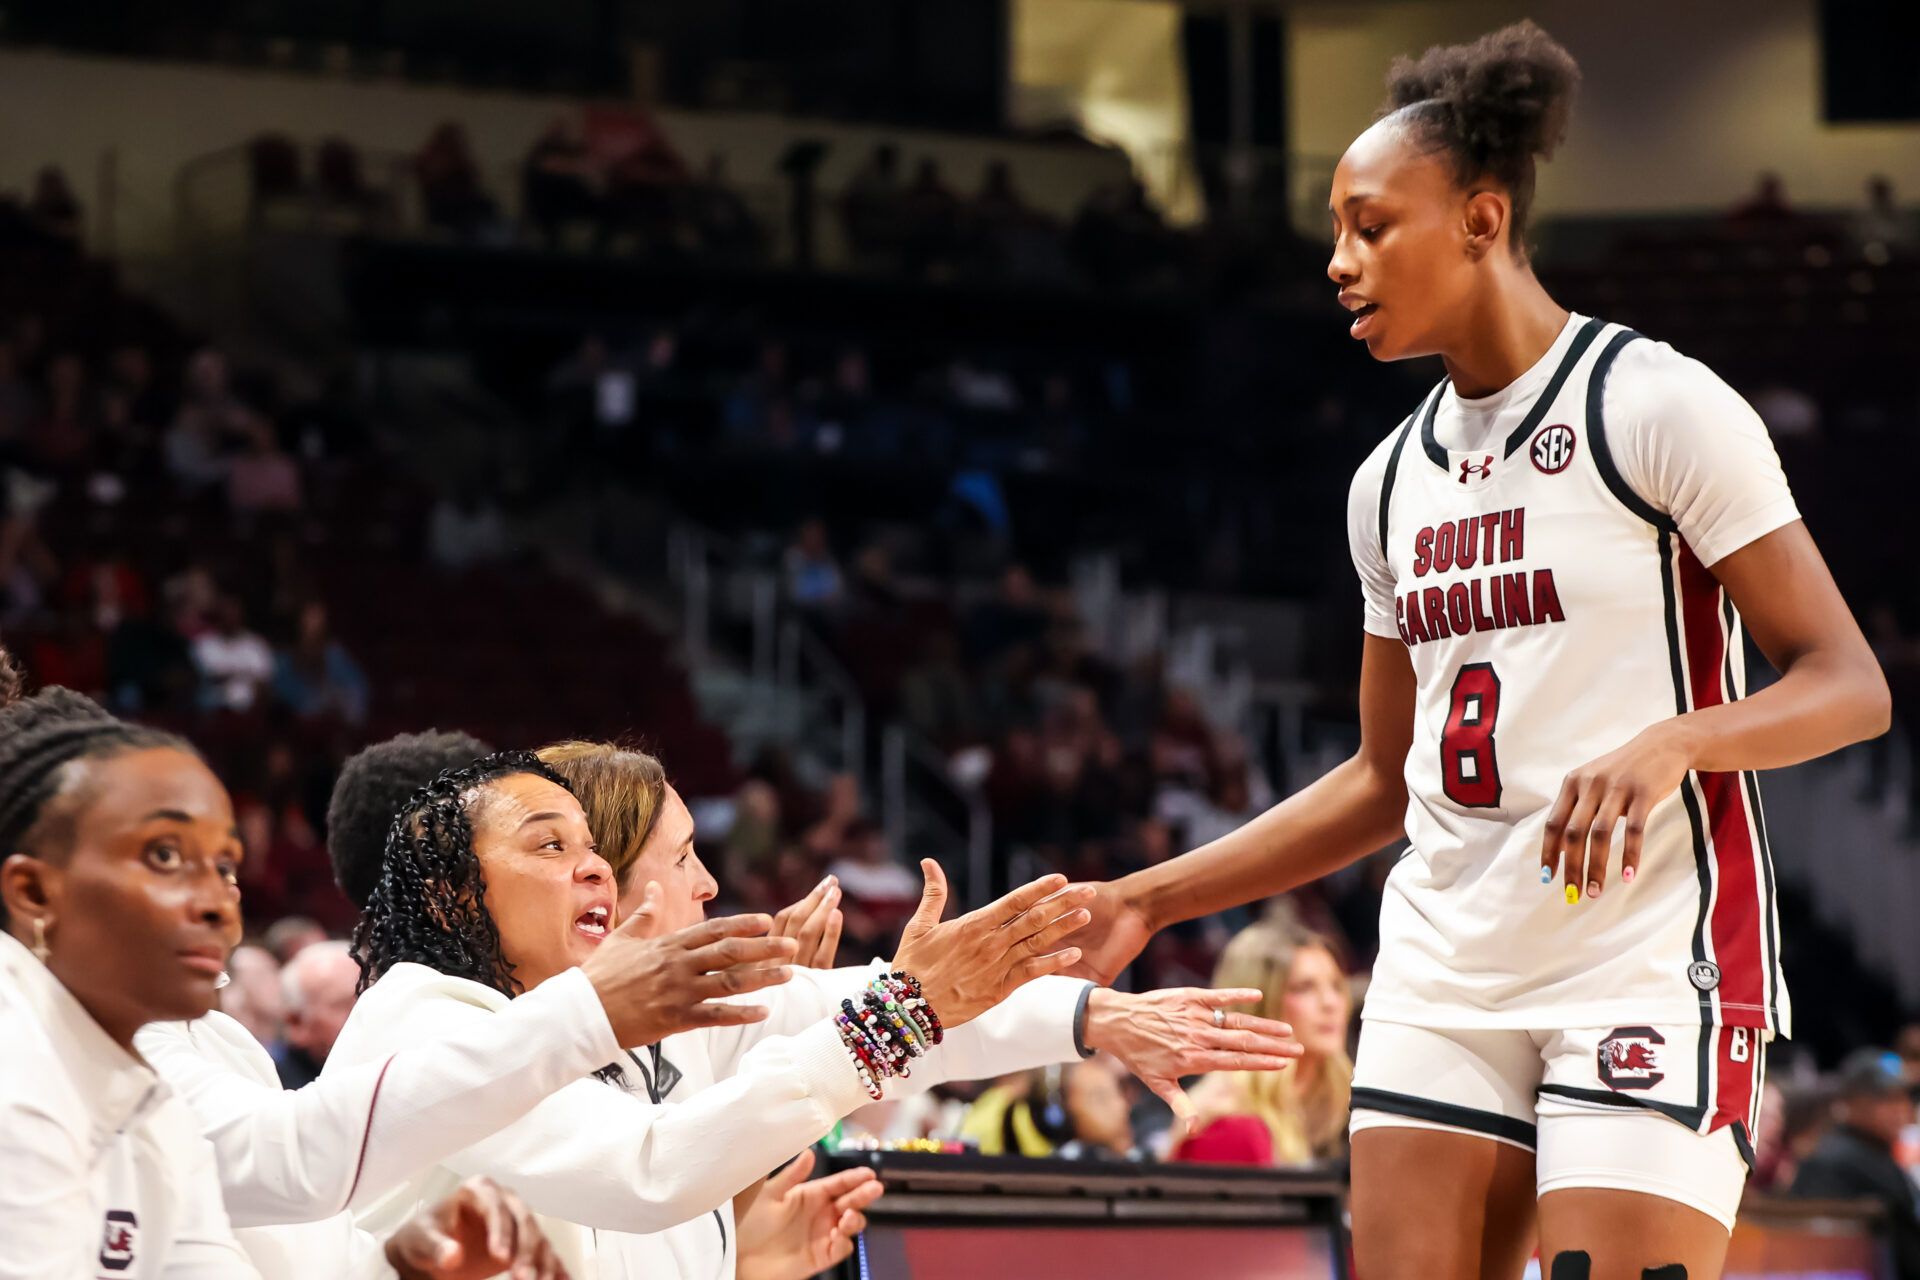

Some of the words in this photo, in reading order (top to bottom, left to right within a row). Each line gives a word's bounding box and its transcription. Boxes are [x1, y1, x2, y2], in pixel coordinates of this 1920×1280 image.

[1534, 427, 1573, 470] SEC
[1412, 507, 1526, 578] SOUTH
[1439, 661, 1504, 809] 8
